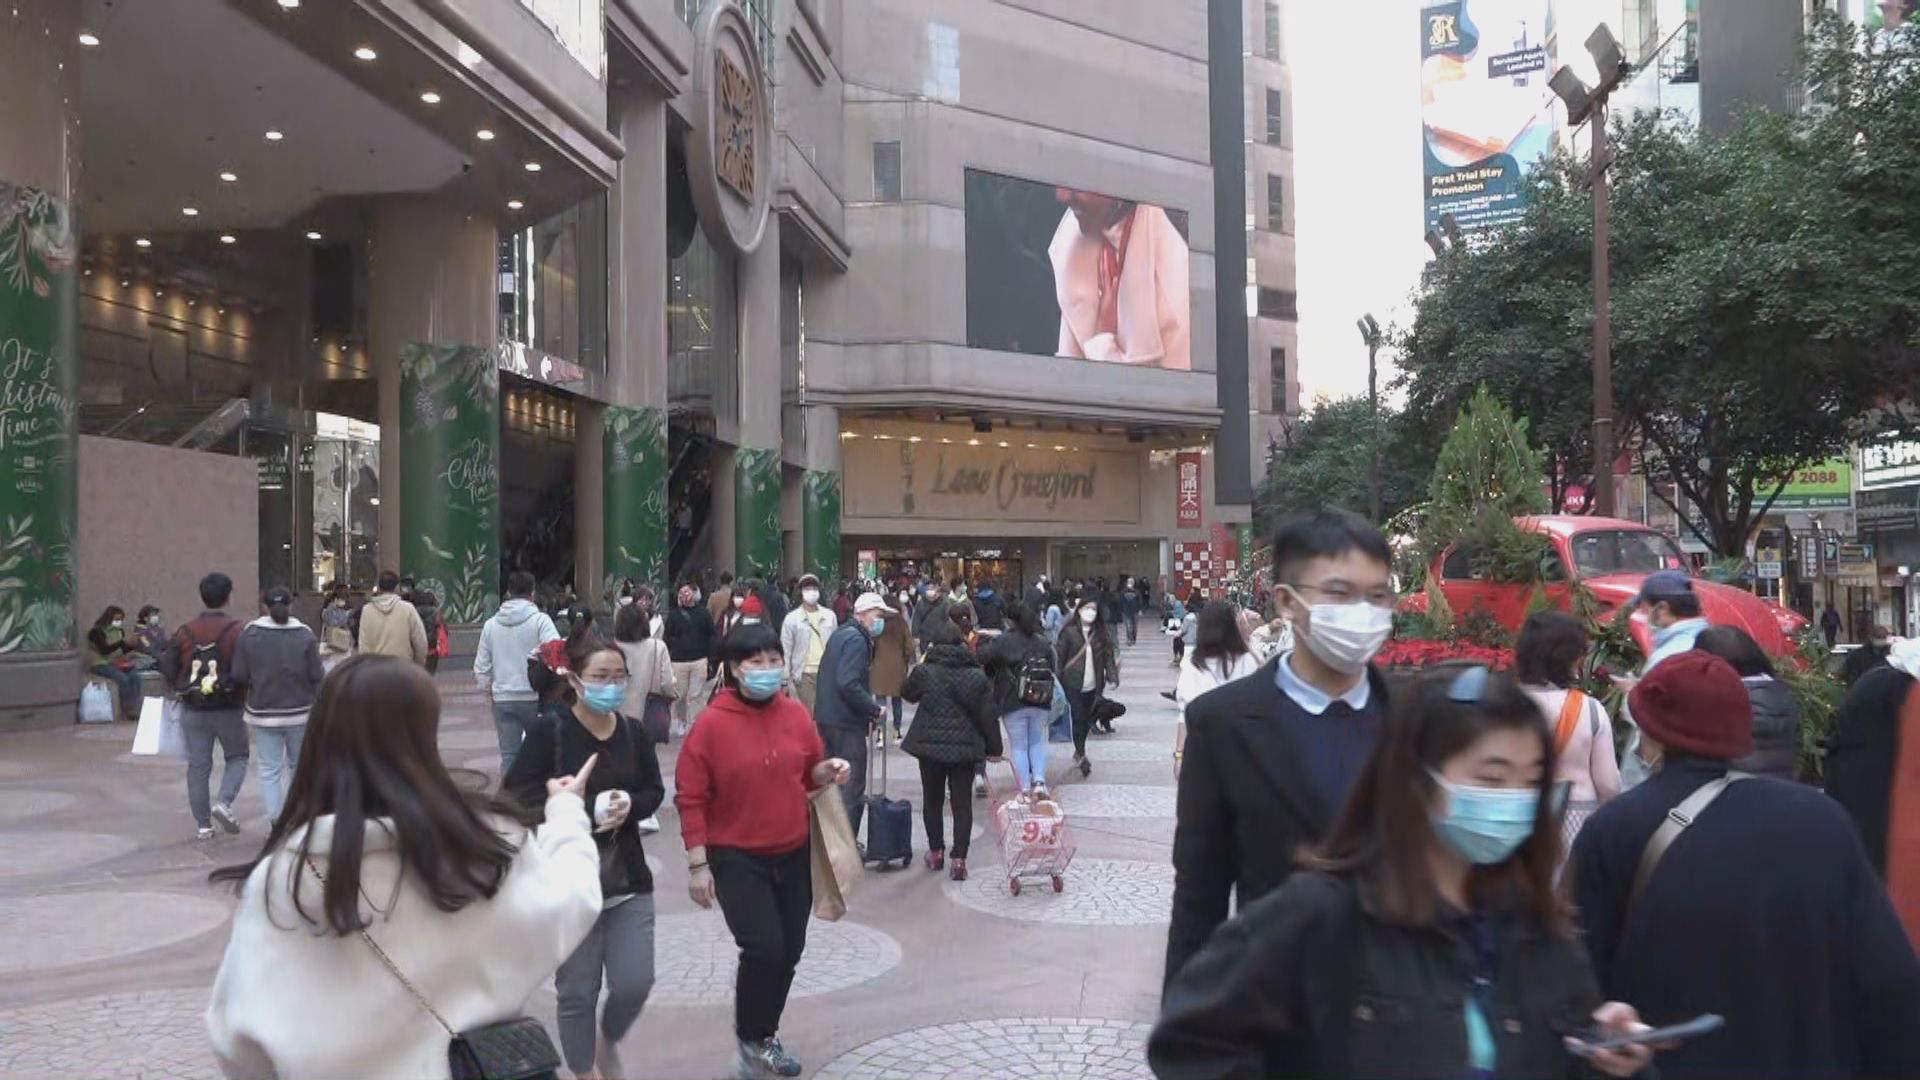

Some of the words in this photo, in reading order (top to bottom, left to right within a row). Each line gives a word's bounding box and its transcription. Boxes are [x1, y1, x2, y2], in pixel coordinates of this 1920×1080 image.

[1431, 174, 1455, 186] First
[1456, 169, 1478, 181] Trial
[1479, 167, 1503, 178] Stay
[1431, 182, 1484, 197] Promotion
[929, 453, 992, 495] Lane
[995, 456, 1097, 511] Crawford
[1800, 471, 1838, 484] 2088
